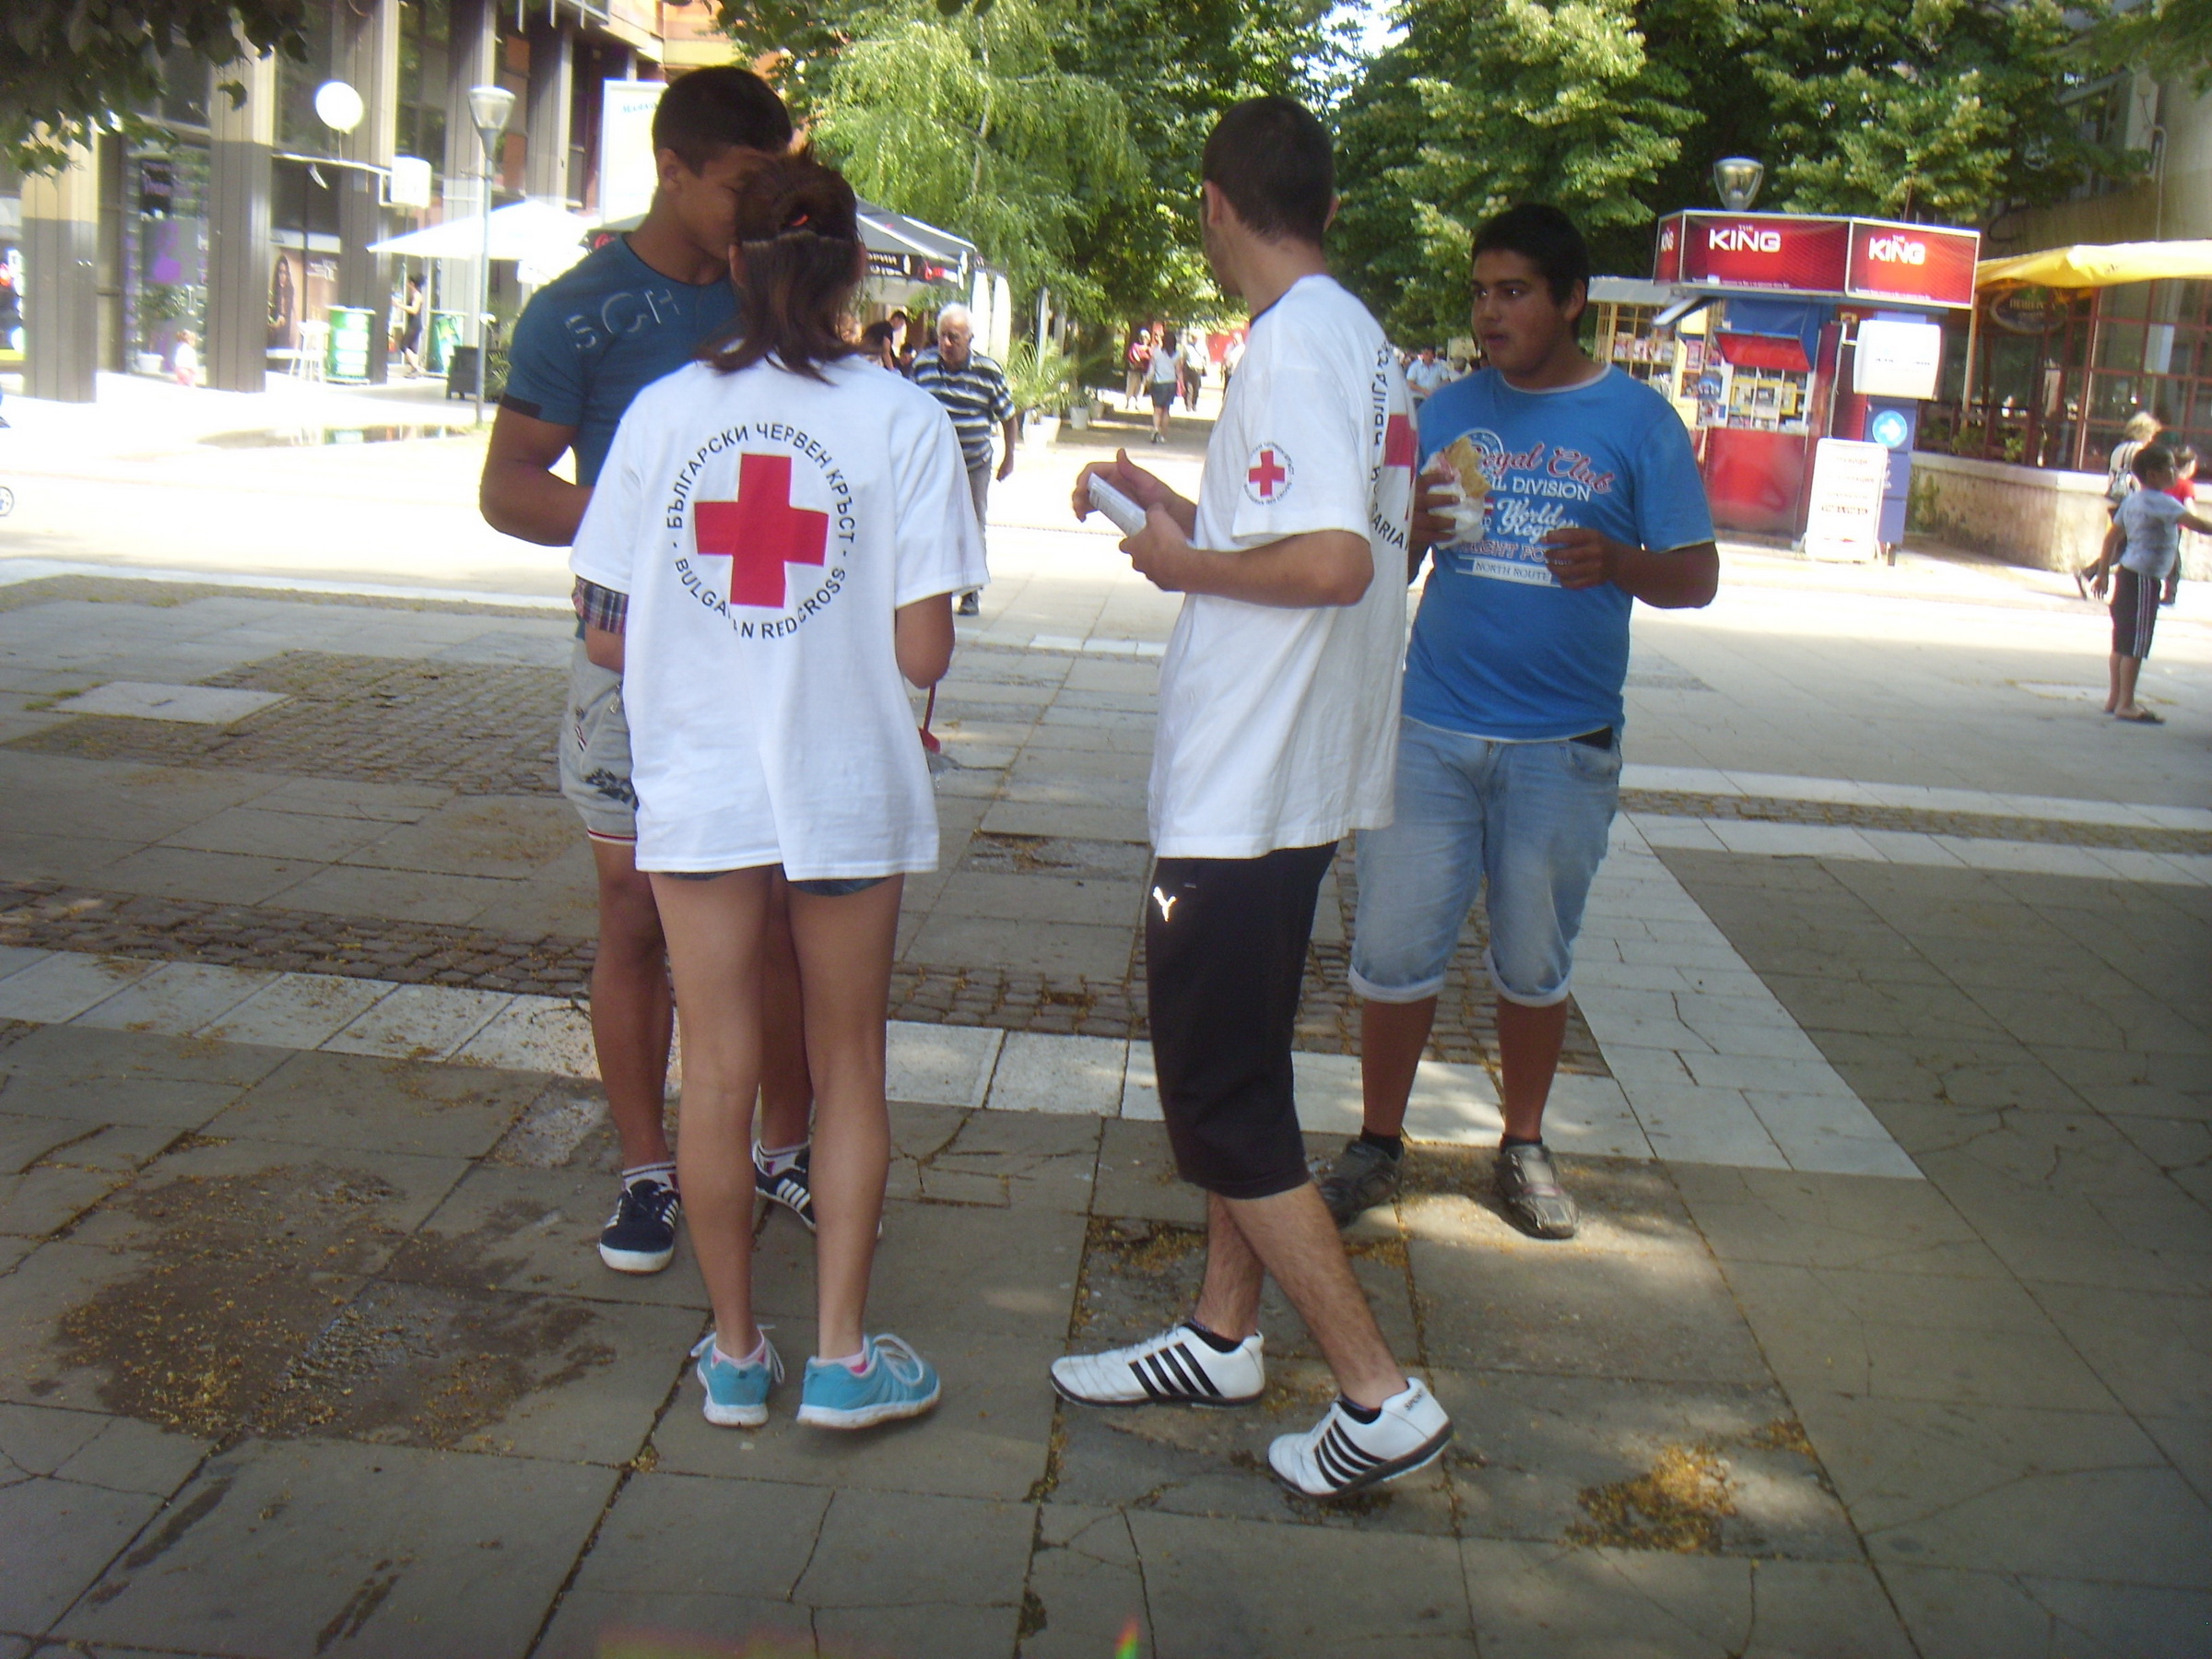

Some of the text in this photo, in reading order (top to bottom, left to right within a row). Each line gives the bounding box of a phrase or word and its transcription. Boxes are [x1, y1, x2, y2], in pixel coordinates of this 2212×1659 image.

[1709, 229, 1781, 253] KING
[1869, 237, 1925, 265] KING
[667, 423, 855, 543] БЪЛГАРСКИ ЧЕРВЕН КРЪСТ
[1547, 446, 1616, 495] Club
[1512, 476, 1594, 503] DIVISION
[1497, 496, 1564, 527] World
[1476, 560, 1512, 575] NORTH
[761, 617, 798, 640] RED
[797, 567, 845, 623] CROSS
